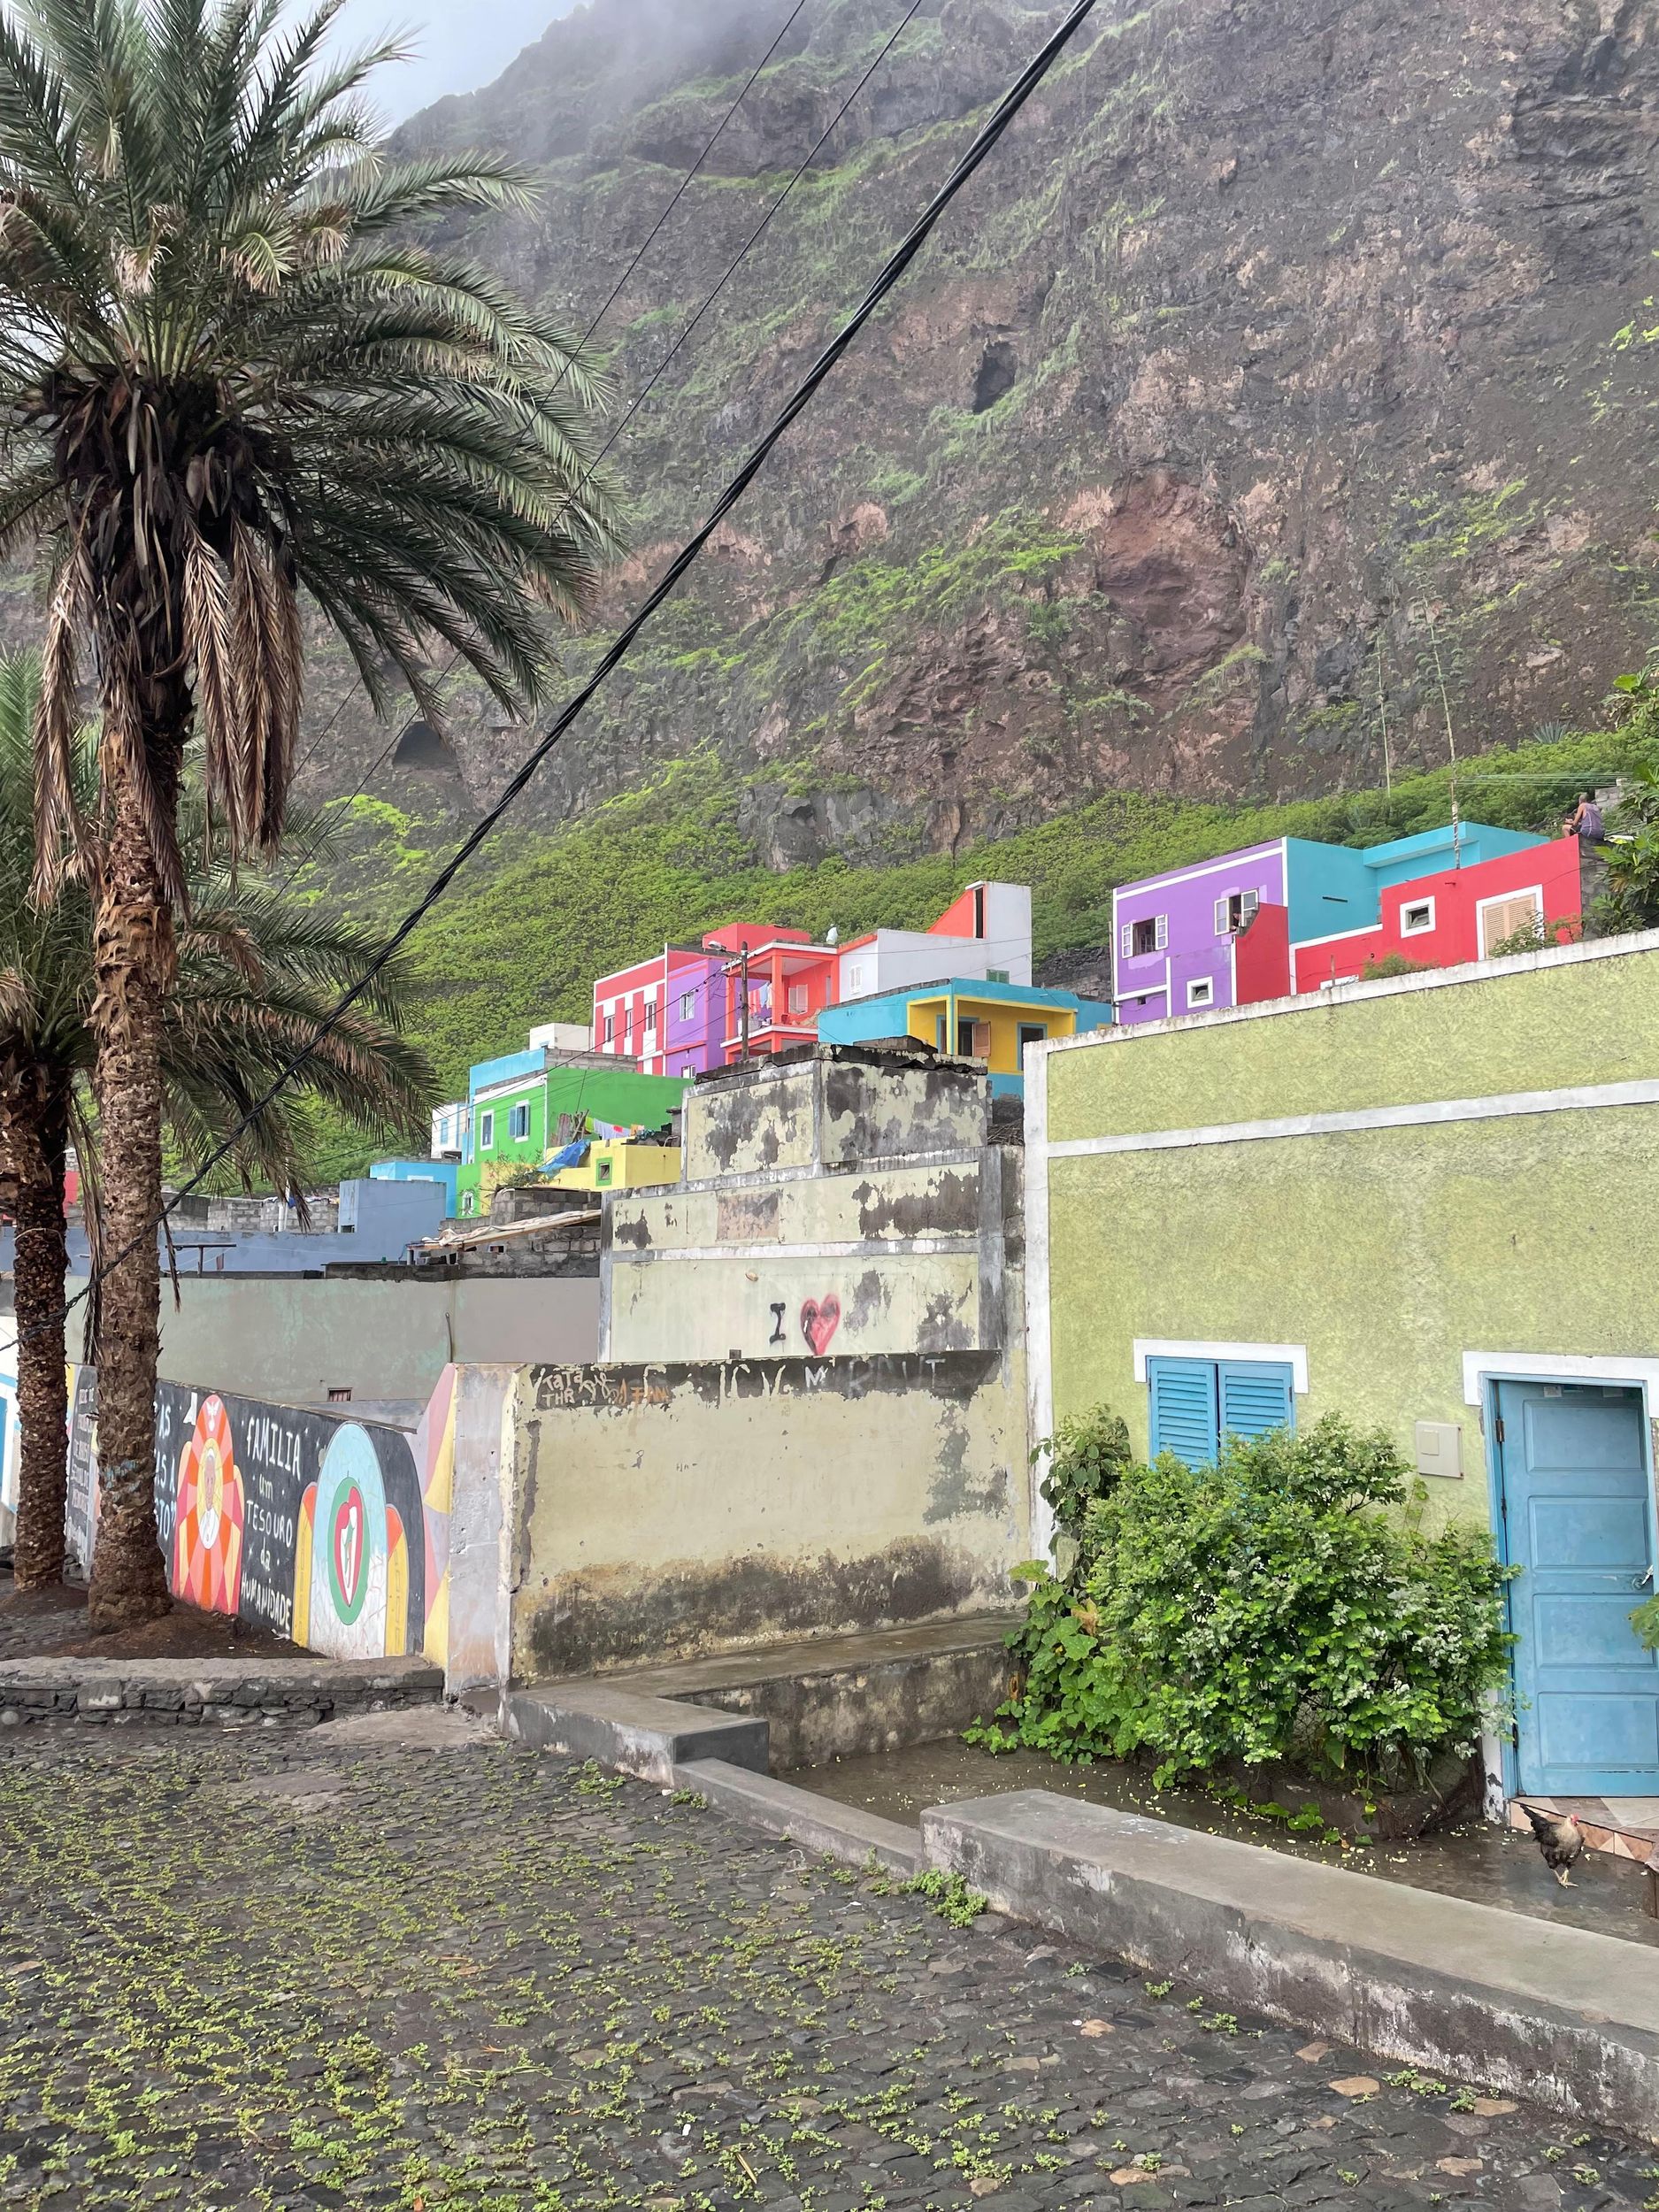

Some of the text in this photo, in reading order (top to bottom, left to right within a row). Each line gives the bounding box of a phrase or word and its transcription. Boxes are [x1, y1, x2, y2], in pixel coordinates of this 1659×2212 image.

[769, 1302, 786, 1344] I
[247, 1416, 301, 1482] FAMILIA
[258, 1474, 273, 1502] um
[246, 1500, 293, 1548] TESOURO
[259, 1536, 271, 1571] da
